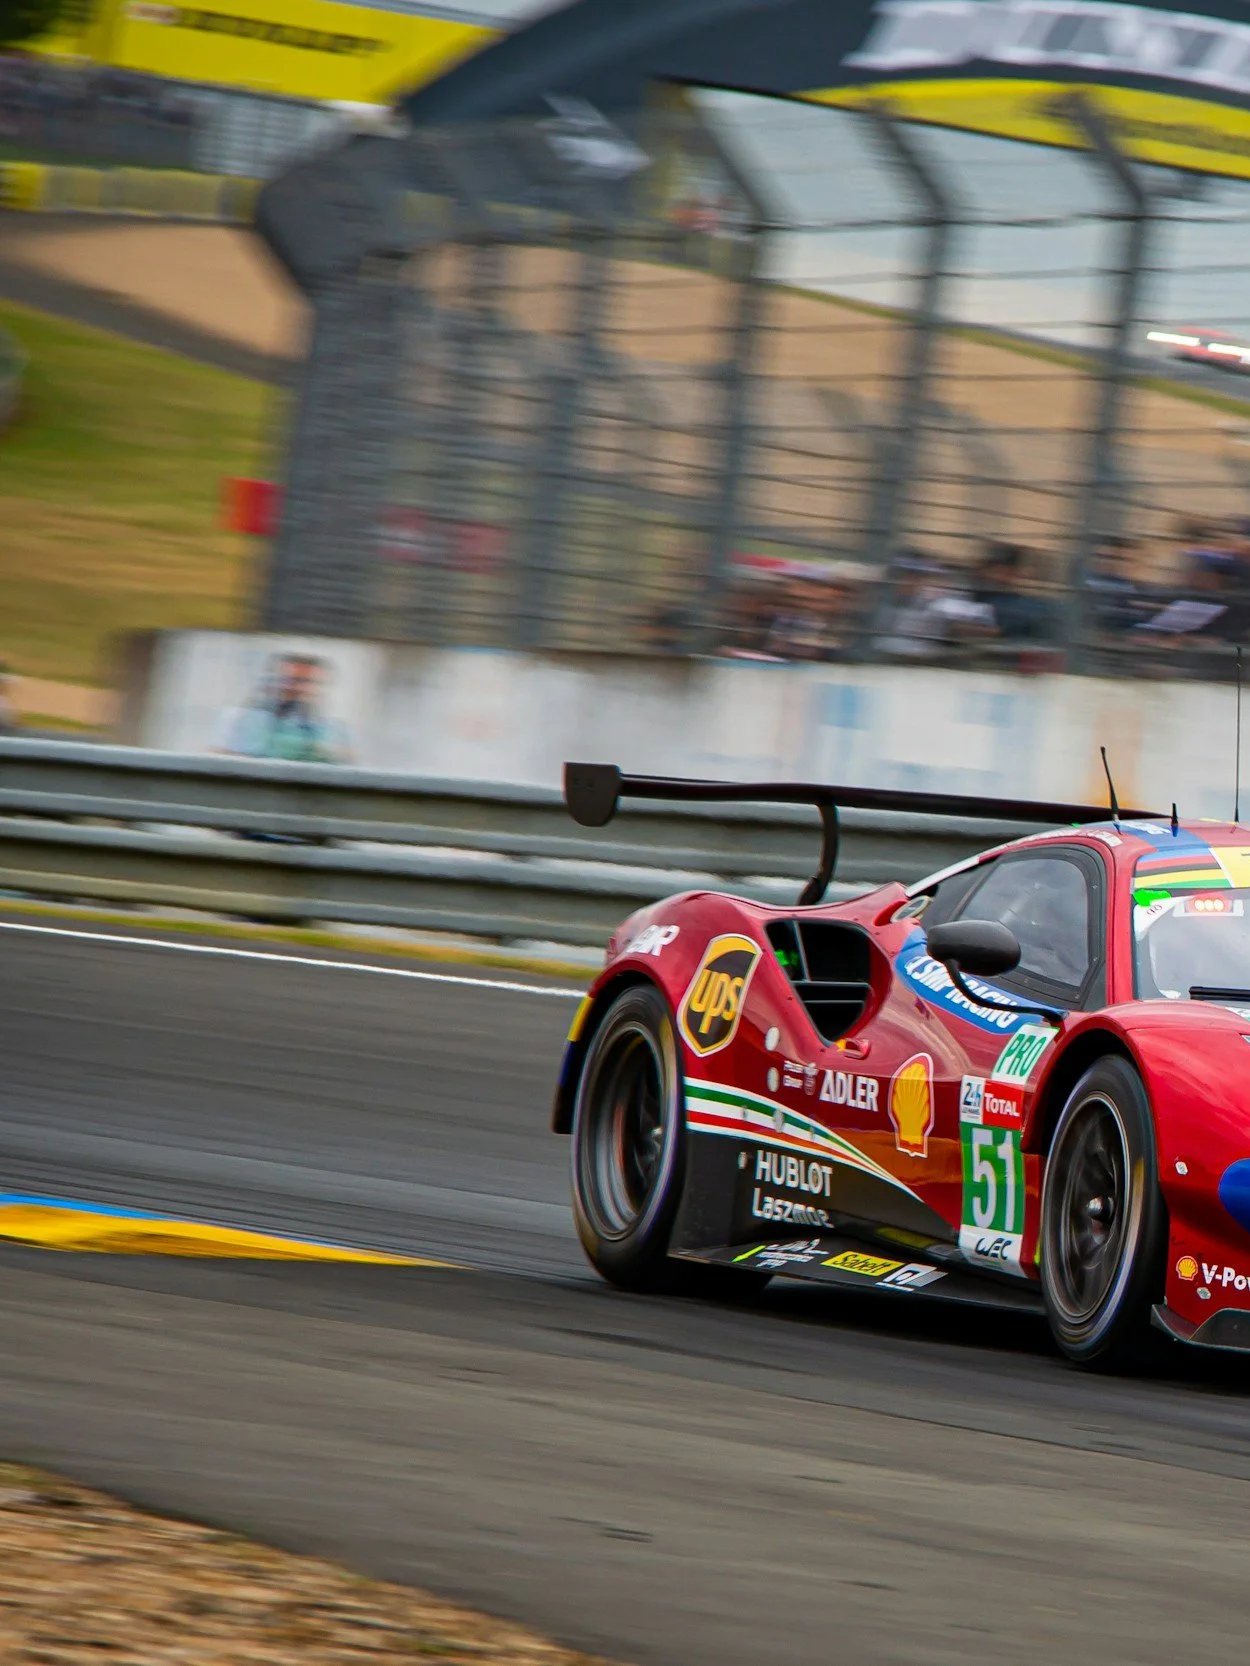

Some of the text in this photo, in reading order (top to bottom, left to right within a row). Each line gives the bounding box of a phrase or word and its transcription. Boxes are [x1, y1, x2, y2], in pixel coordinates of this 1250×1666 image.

[689, 968, 745, 1034] ups
[996, 1033, 1048, 1078] PRO
[819, 1069, 880, 1112] ADLER
[984, 1092, 1020, 1117] TOTAL
[755, 1149, 833, 1197] HUBLOT
[971, 1127, 1016, 1232] 51
[974, 1237, 1012, 1260] WEC
